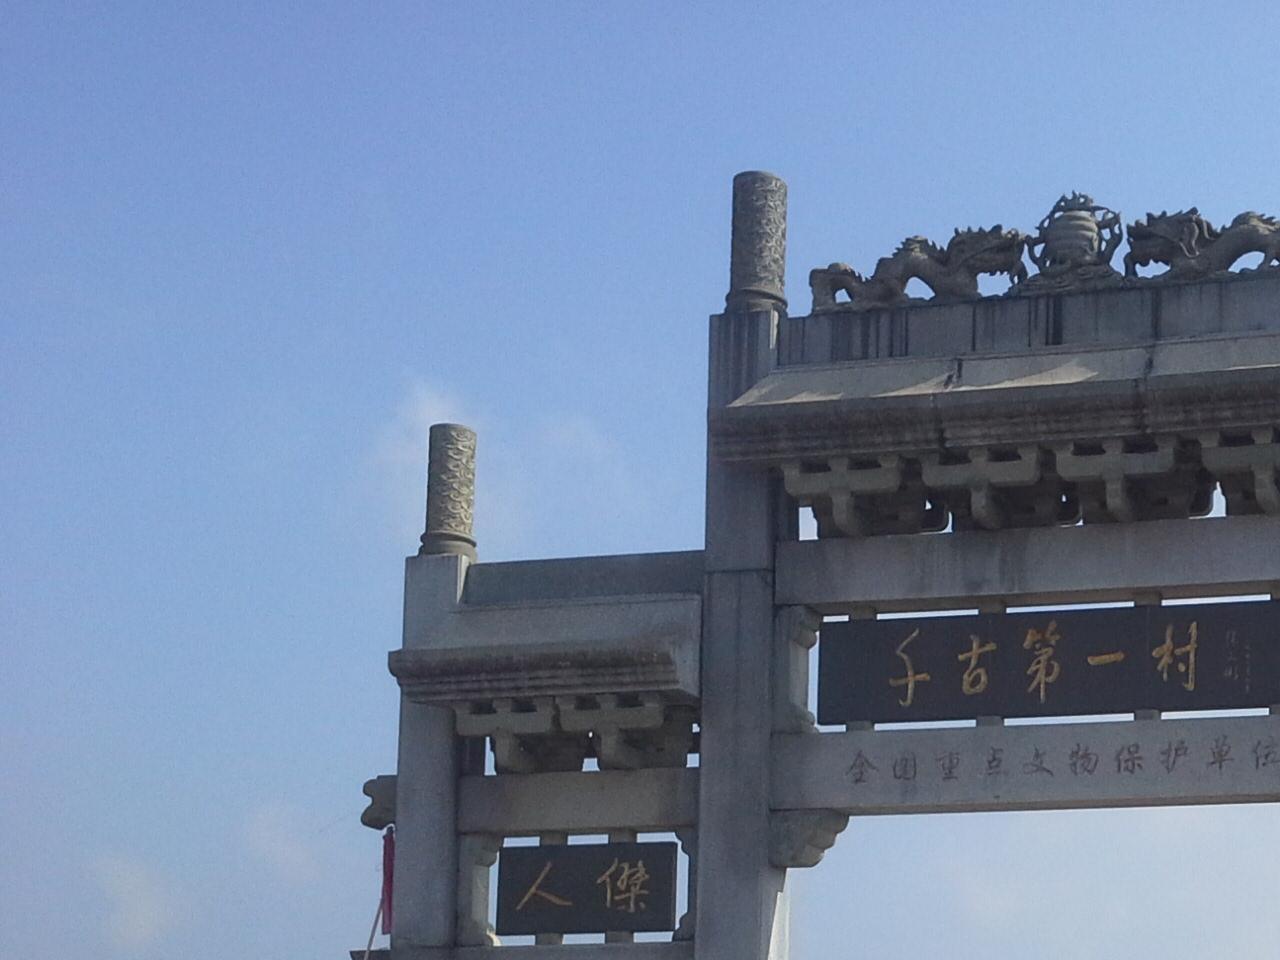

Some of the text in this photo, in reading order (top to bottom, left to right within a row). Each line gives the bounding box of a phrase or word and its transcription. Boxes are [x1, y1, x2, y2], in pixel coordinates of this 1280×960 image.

[889, 619, 1199, 708] 千古第一村
